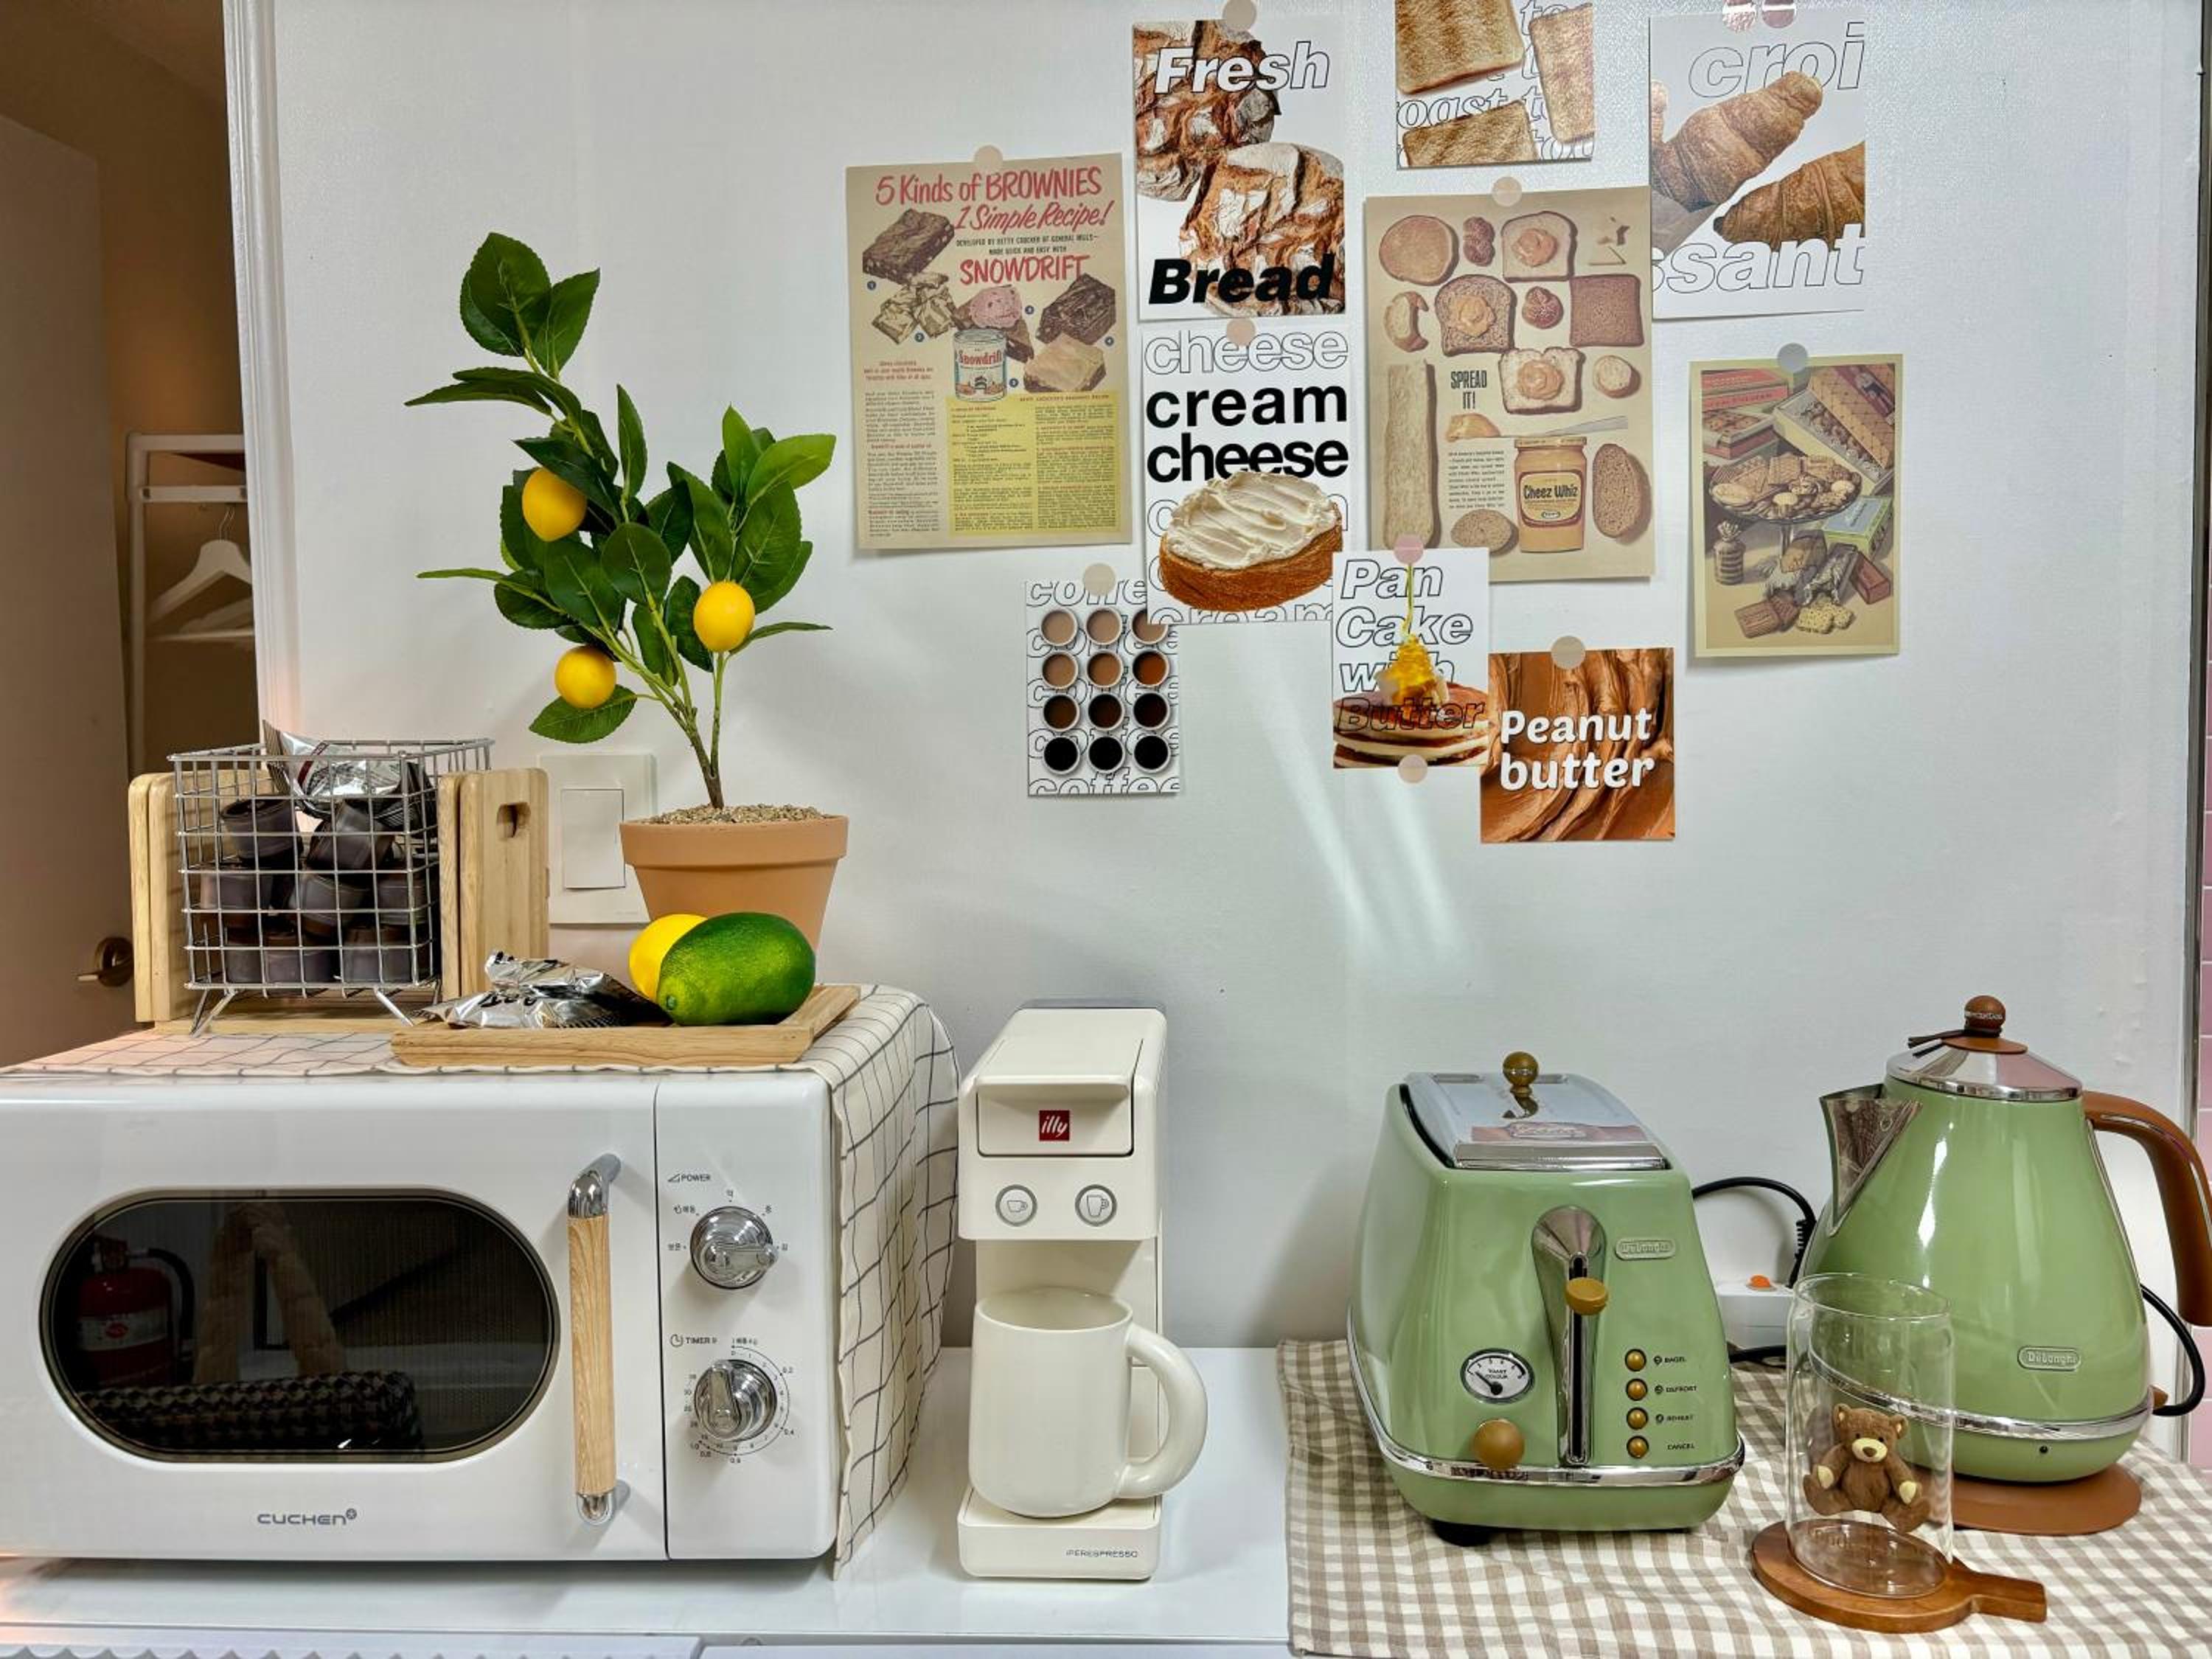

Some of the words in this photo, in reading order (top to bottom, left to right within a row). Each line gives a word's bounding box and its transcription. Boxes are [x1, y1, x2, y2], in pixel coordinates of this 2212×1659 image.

[1154, 41, 1329, 94] Fresh
[1688, 22, 1864, 97] croi
[1397, 88, 1508, 129] oast
[875, 174, 895, 206] 5
[900, 173, 954, 205] Kinds
[959, 172, 982, 201] of
[985, 166, 1102, 201] BROWNIES
[970, 204, 1037, 234] Simple
[1037, 200, 1115, 232] Recipe!
[960, 255, 1091, 285] SNOWDRIFT
[1149, 253, 1335, 305] Bread
[1144, 330, 1349, 375] cheese
[1450, 370, 1488, 390] SPREAD
[1146, 385, 1347, 428] cream
[1462, 392, 1476, 409] IT!
[1147, 433, 1349, 483] cheese
[1523, 484, 1552, 499] Cheez
[1554, 484, 1578, 498] Whiz
[1340, 559, 1443, 599] Pan
[1336, 606, 1473, 647] Cake
[1338, 697, 1485, 731] Butter
[1500, 707, 1653, 745] Peanut
[1500, 751, 1655, 791] butter
[1040, 1116, 1068, 1138] illy
[681, 1174, 711, 1182] POWER
[257, 1514, 347, 1526] CUCHEN
